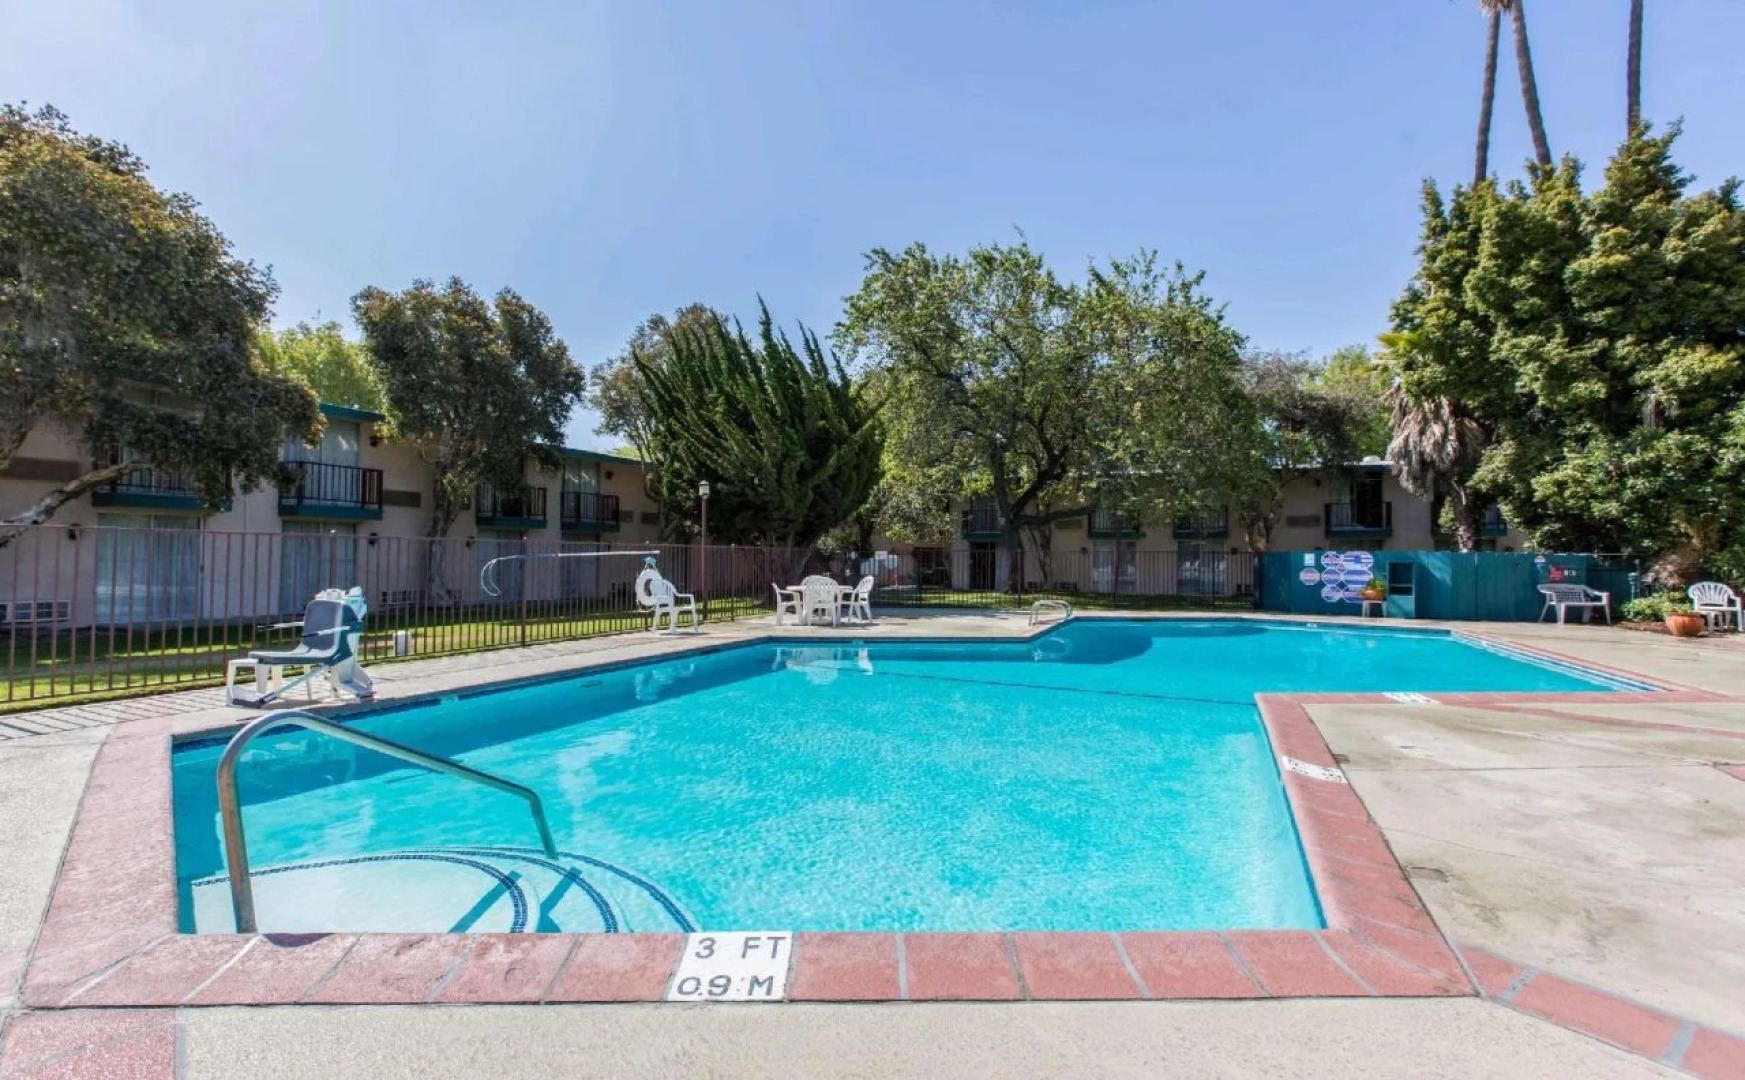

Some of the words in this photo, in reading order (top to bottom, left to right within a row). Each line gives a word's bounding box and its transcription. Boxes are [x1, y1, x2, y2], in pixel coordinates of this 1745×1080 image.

[695, 936, 716, 959] 3
[741, 936, 786, 959] FT
[677, 974, 732, 996] 0.9
[748, 975, 774, 996] M
